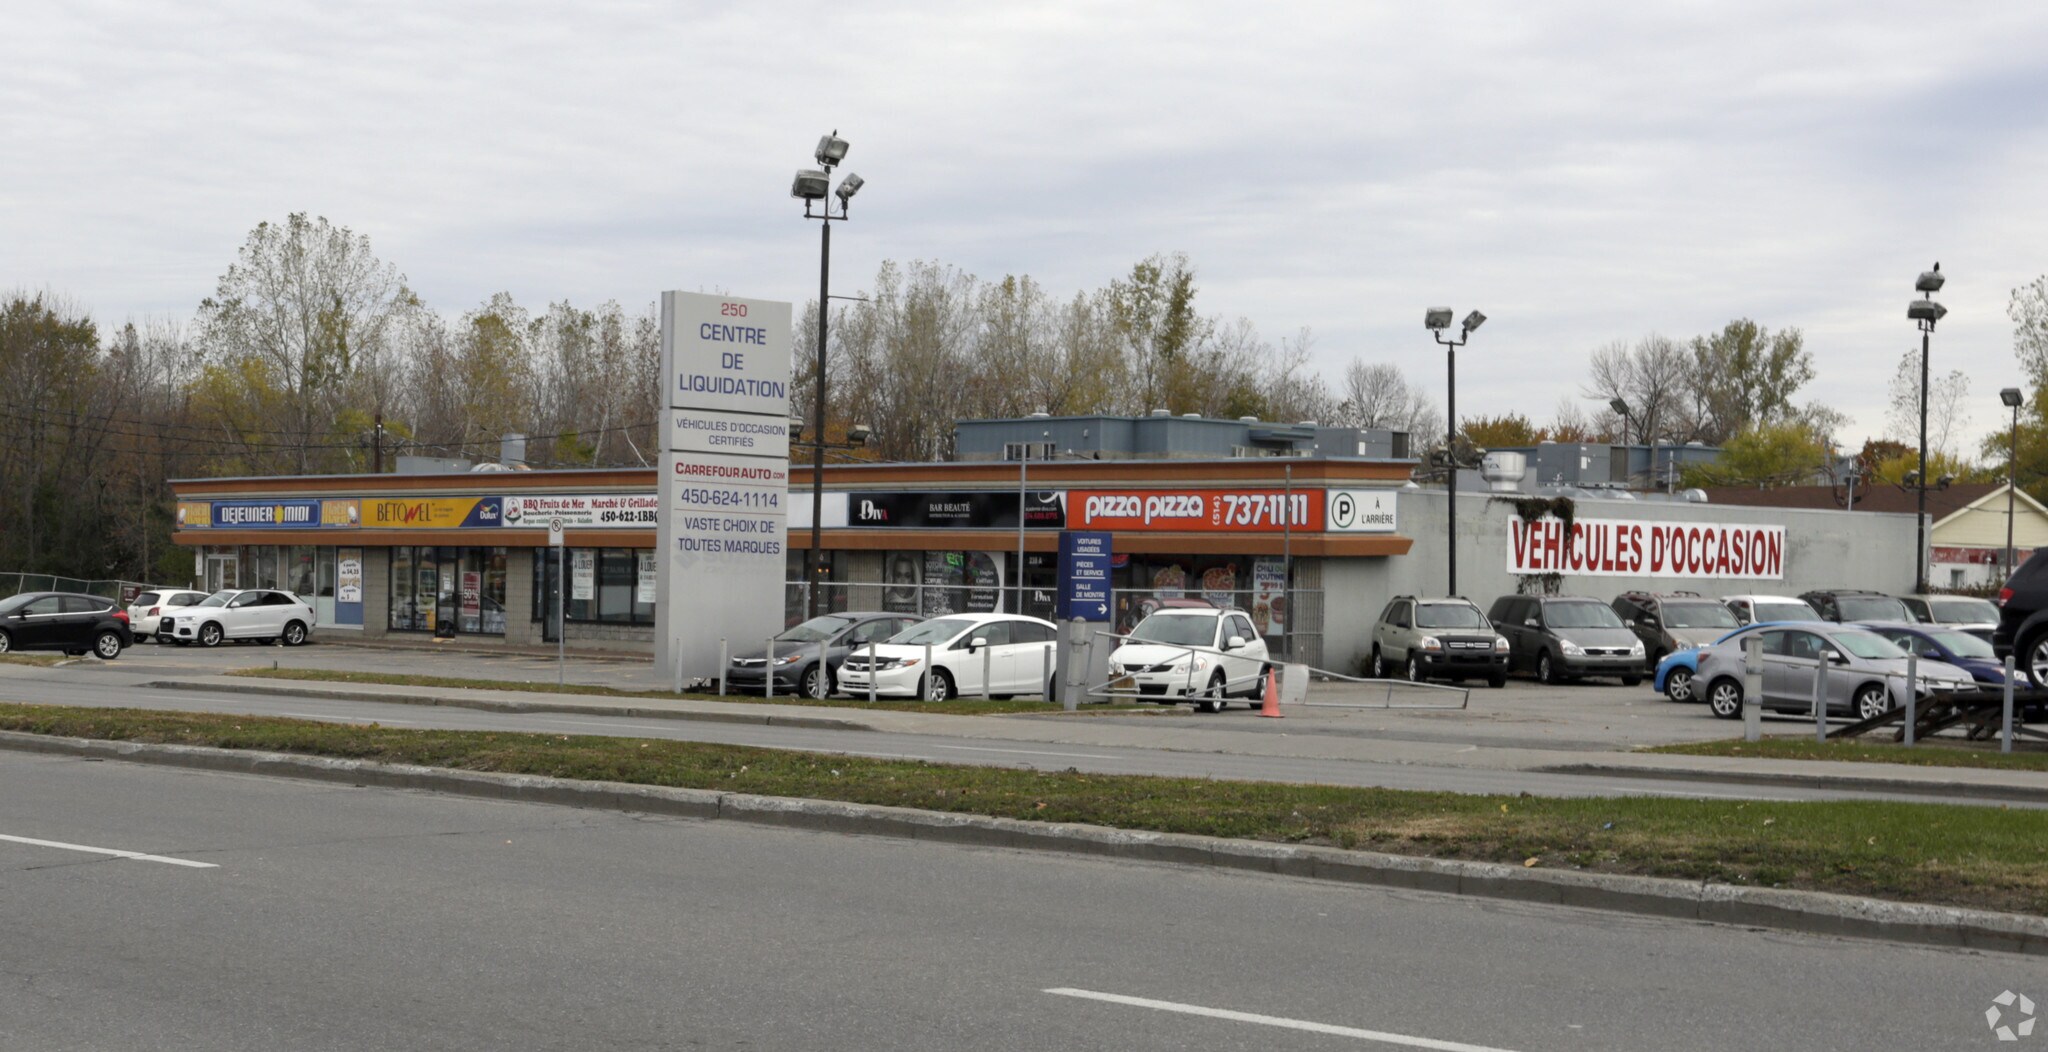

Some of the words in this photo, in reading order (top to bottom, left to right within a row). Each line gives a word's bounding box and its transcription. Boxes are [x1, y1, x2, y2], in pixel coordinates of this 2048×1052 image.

[721, 303, 747, 317] 250
[700, 323, 766, 345] CENTRE
[722, 352, 744, 370] DE
[680, 373, 785, 398] LIQUIDATION
[676, 418, 728, 432] VÉHICULES
[730, 422, 786, 436] D'OCCASION
[708, 435, 754, 448] CERTIFIÉS
[523, 499, 538, 511] BBQ
[540, 499, 560, 509] Fruits
[562, 499, 570, 509] de
[572, 499, 585, 509] Mer
[591, 498, 618, 509] Marché
[628, 498, 658, 508] Grillade
[681, 488, 778, 508] 450-624-1114
[1375, 496, 1380, 509] À
[930, 503, 943, 512] BAR
[944, 501, 971, 512] BEAUTÉ
[1212, 495, 1221, 526] (514)
[284, 506, 309, 522] MIDI
[480, 510, 498, 520] Dulux
[1361, 511, 1394, 525] L'ARRIÈRE
[684, 517, 721, 531] VASTE
[723, 519, 757, 533] CHOIX
[760, 521, 775, 533] DE
[678, 538, 721, 553] TOUTES
[724, 540, 780, 555] MARQUES
[1077, 538, 1102, 546] VOITURES
[1650, 525, 1782, 576] D'OCCASION
[645, 561, 657, 573] LOUE
[1256, 564, 1274, 573] CHILI
[1256, 573, 1285, 581] POUTINE
[464, 588, 479, 599] 50%
